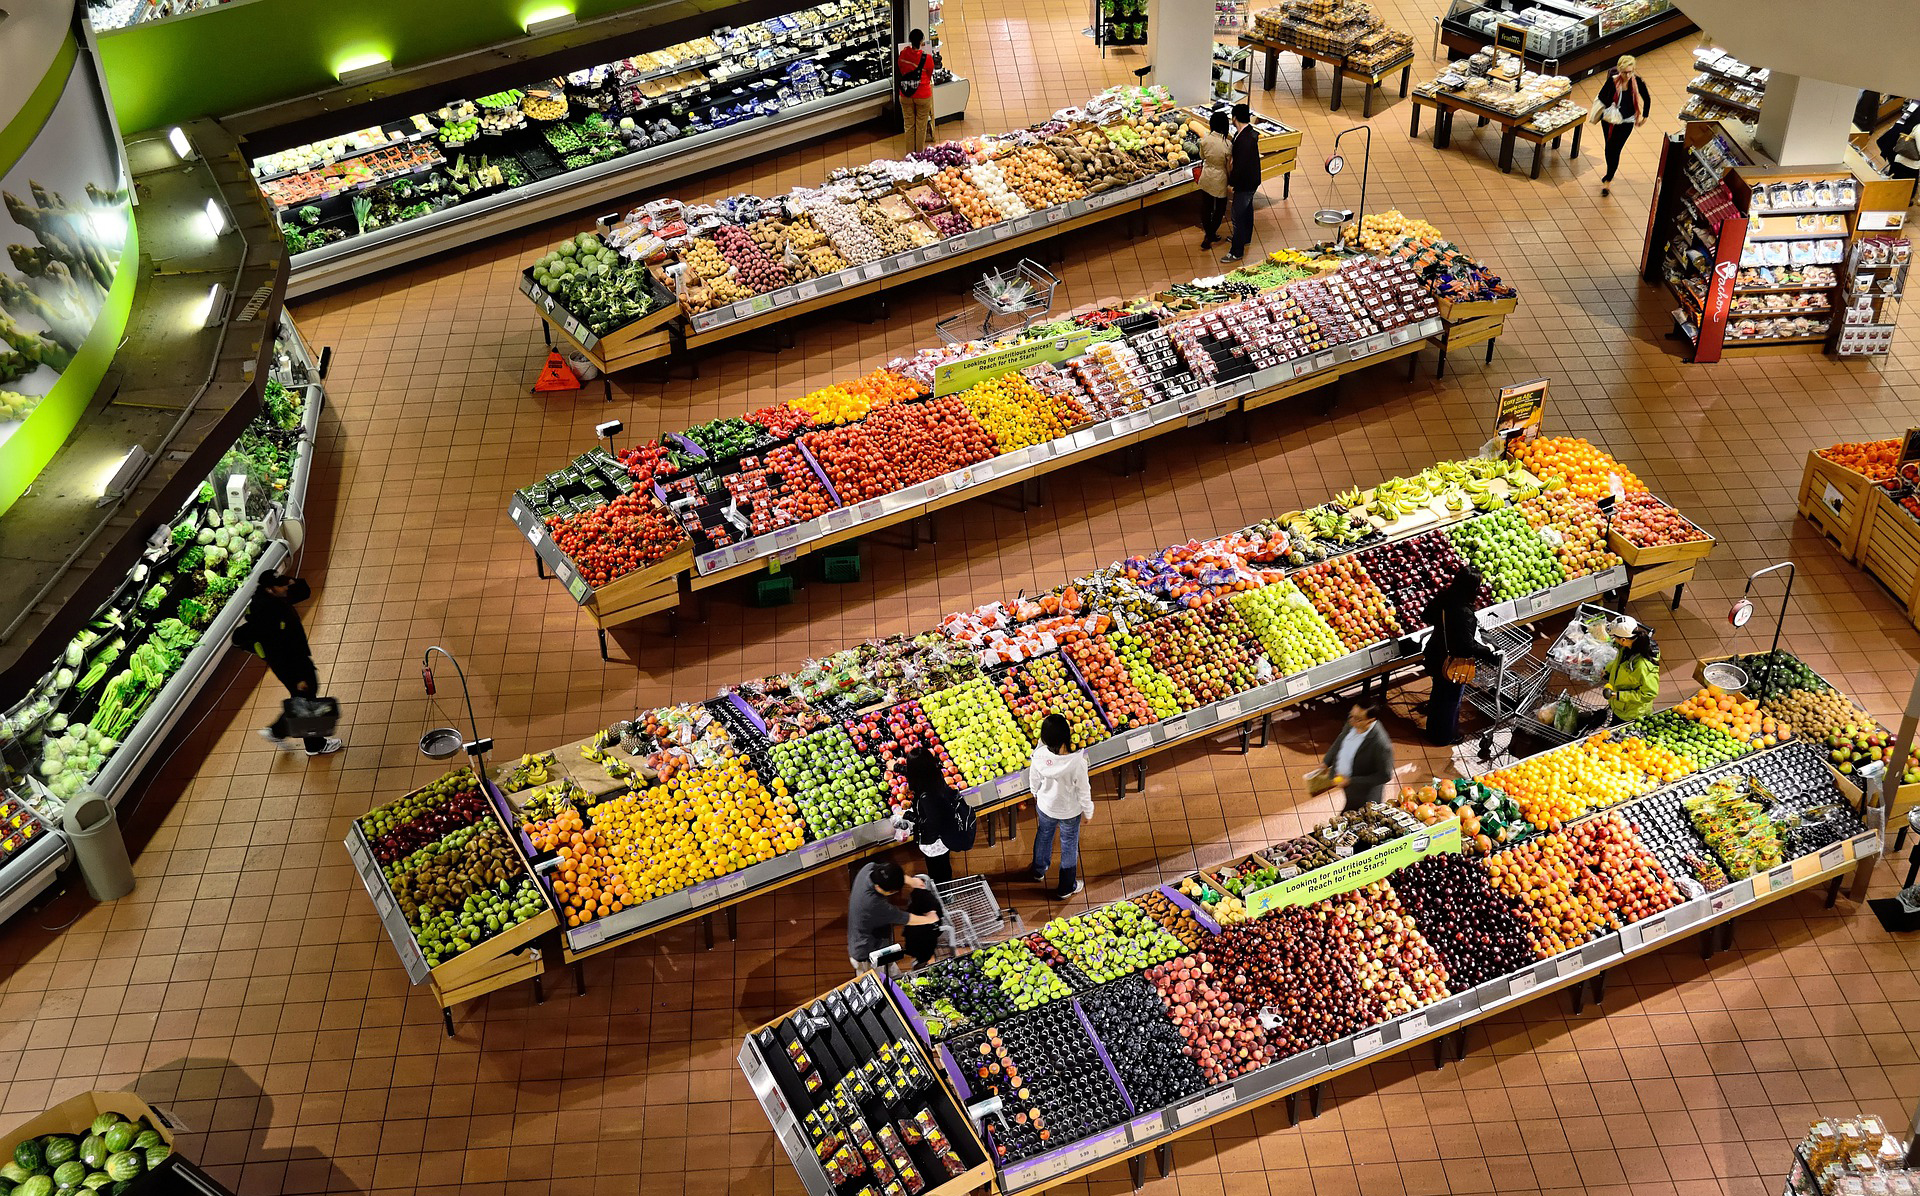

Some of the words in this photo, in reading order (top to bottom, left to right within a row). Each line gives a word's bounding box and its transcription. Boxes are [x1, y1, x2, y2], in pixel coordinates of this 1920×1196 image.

[1714, 261, 1737, 322] Vachon
[963, 359, 987, 369] Looking
[998, 349, 1026, 360] nutritious
[1028, 342, 1053, 352] choices?
[979, 362, 997, 371] Reach
[1019, 352, 1037, 361] Stars!
[1286, 878, 1317, 893] Looking
[1319, 872, 1331, 880] for
[1333, 857, 1372, 875] nutritious
[1374, 842, 1408, 860] choices?
[1308, 880, 1333, 893] Reach
[1335, 874, 1345, 883] for
[1348, 869, 1361, 878] the
[1364, 858, 1387, 872] Stars!
